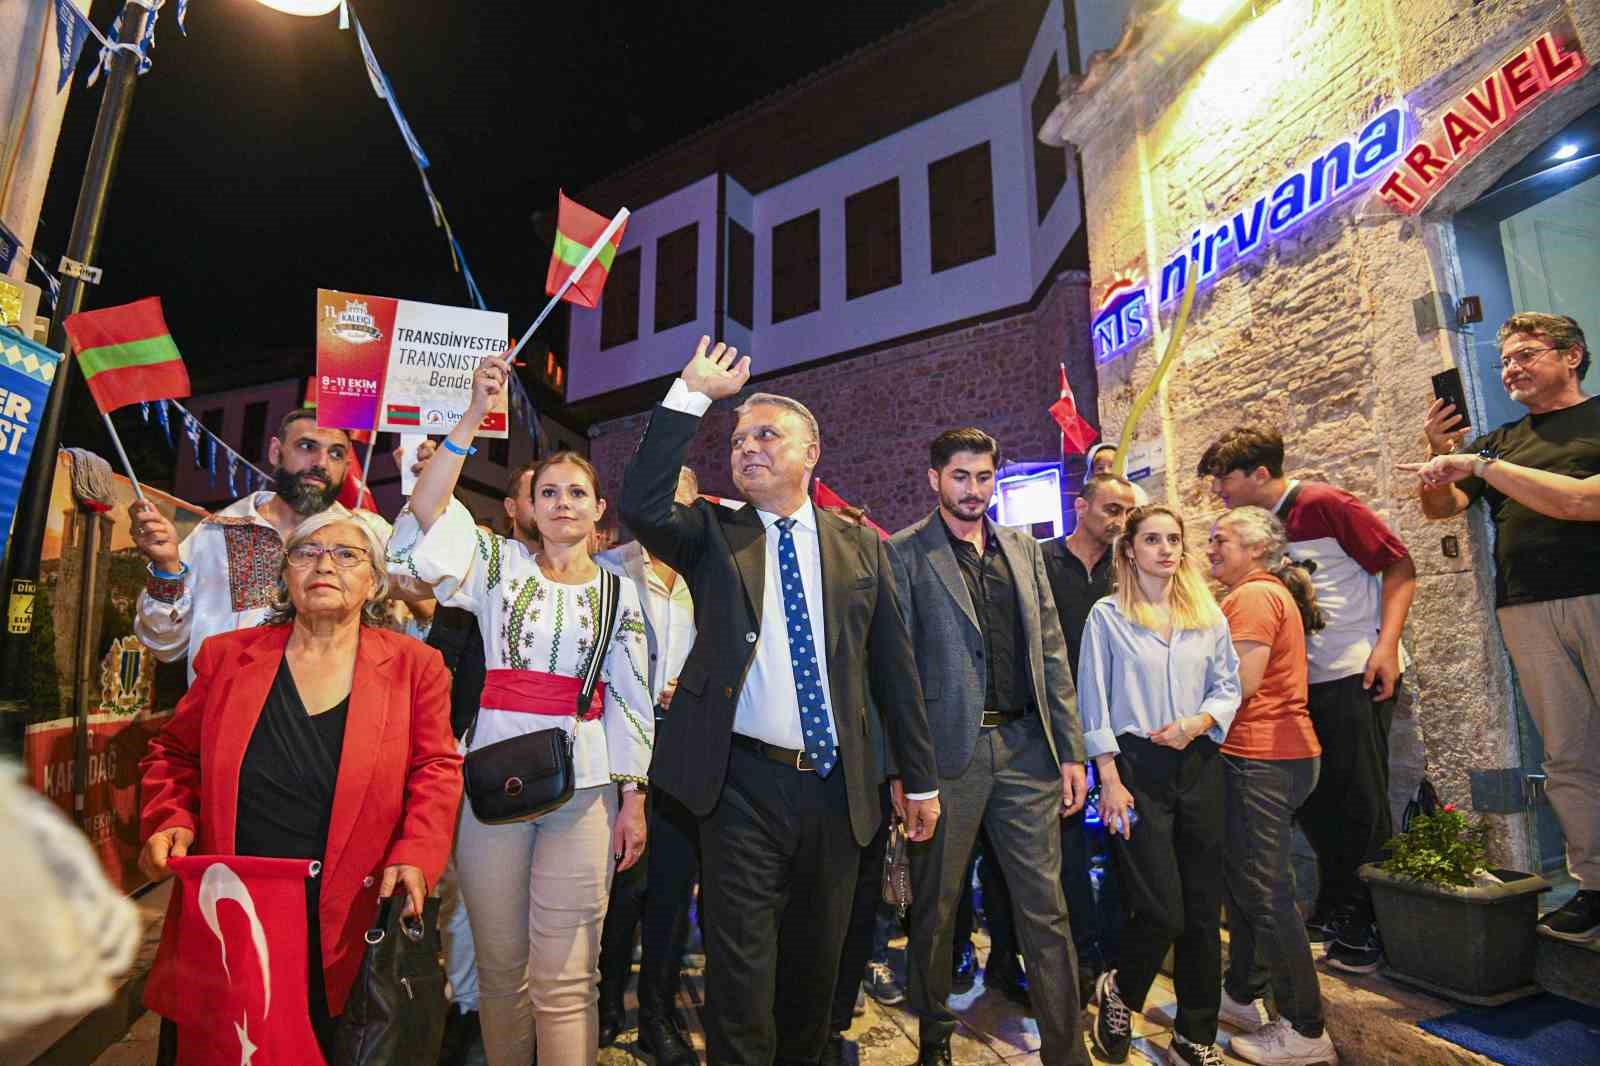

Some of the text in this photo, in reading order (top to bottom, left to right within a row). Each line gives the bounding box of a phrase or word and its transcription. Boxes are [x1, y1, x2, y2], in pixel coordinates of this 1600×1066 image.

[1378, 34, 1581, 206] TRAVEL
[1159, 106, 1402, 304] nirvana
[397, 327, 507, 352] TRANSDİNYESTER
[429, 370, 472, 390] Bende
